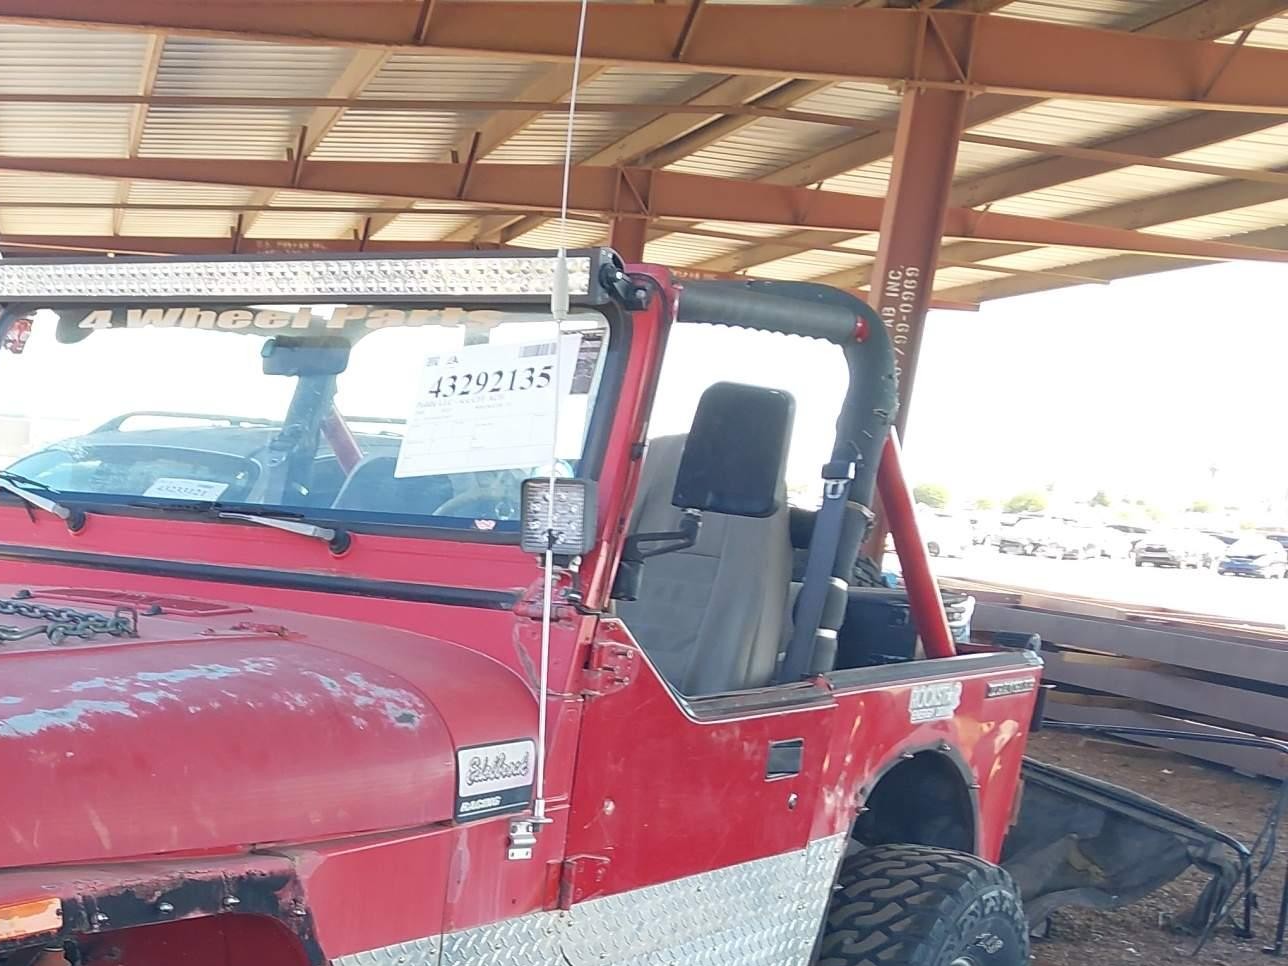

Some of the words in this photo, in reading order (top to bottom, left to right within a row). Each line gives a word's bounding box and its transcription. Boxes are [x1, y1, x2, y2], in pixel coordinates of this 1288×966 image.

[77, 309, 112, 330] 4
[125, 305, 312, 330] Wheel
[326, 304, 505, 331] Parts
[428, 364, 554, 399] 43292135
